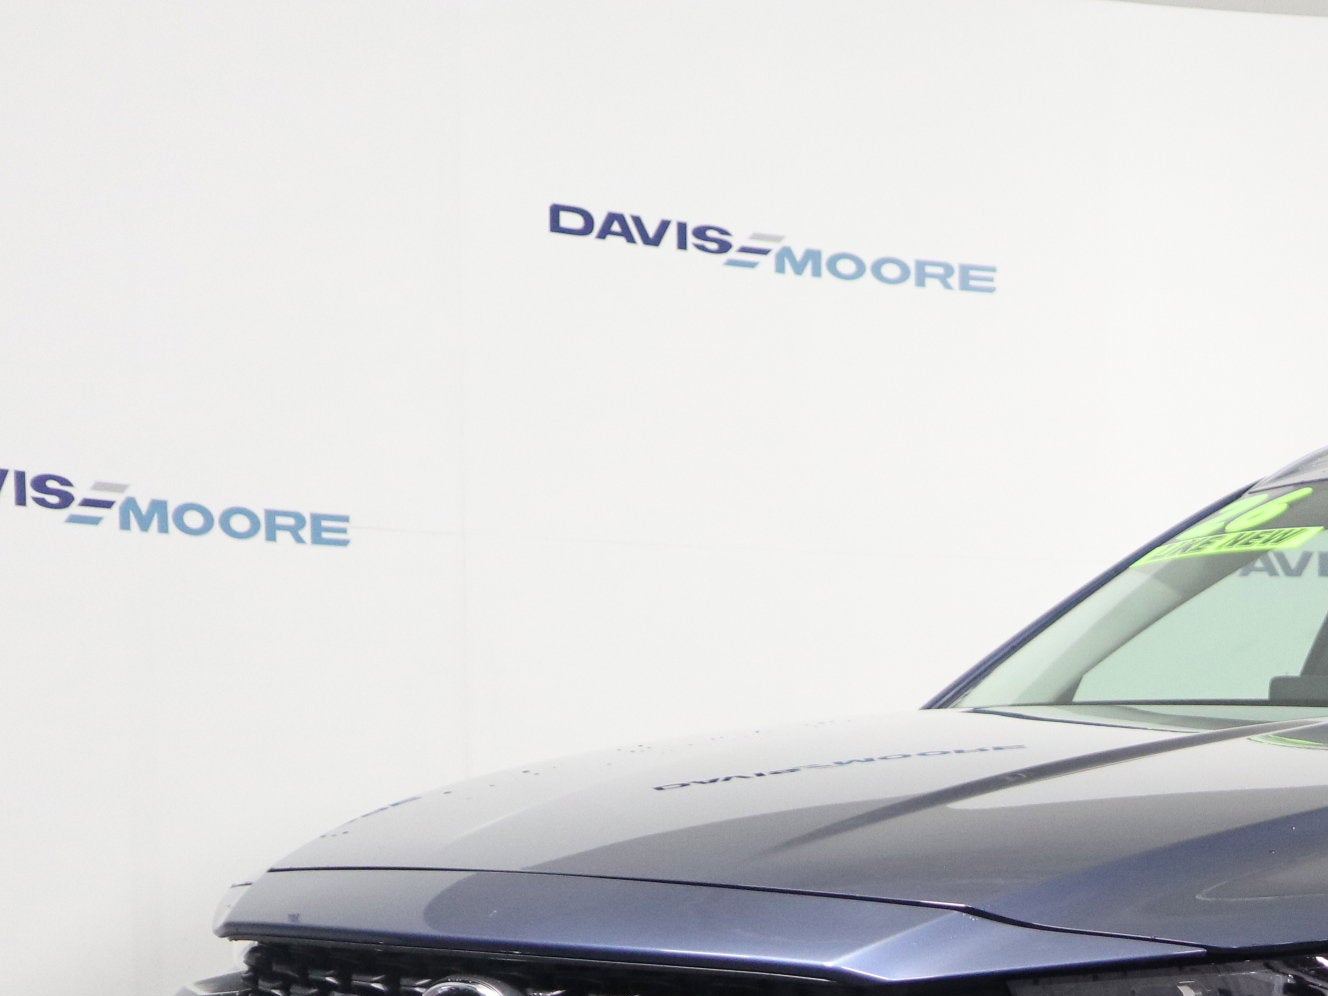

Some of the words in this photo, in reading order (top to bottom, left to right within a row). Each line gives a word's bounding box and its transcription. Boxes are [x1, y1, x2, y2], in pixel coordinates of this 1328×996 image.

[548, 203, 733, 255] DAVIS
[774, 246, 997, 294] MOORE
[0, 468, 76, 510] IS
[118, 496, 351, 547] MOORE
[1220, 528, 1307, 548] NEW
